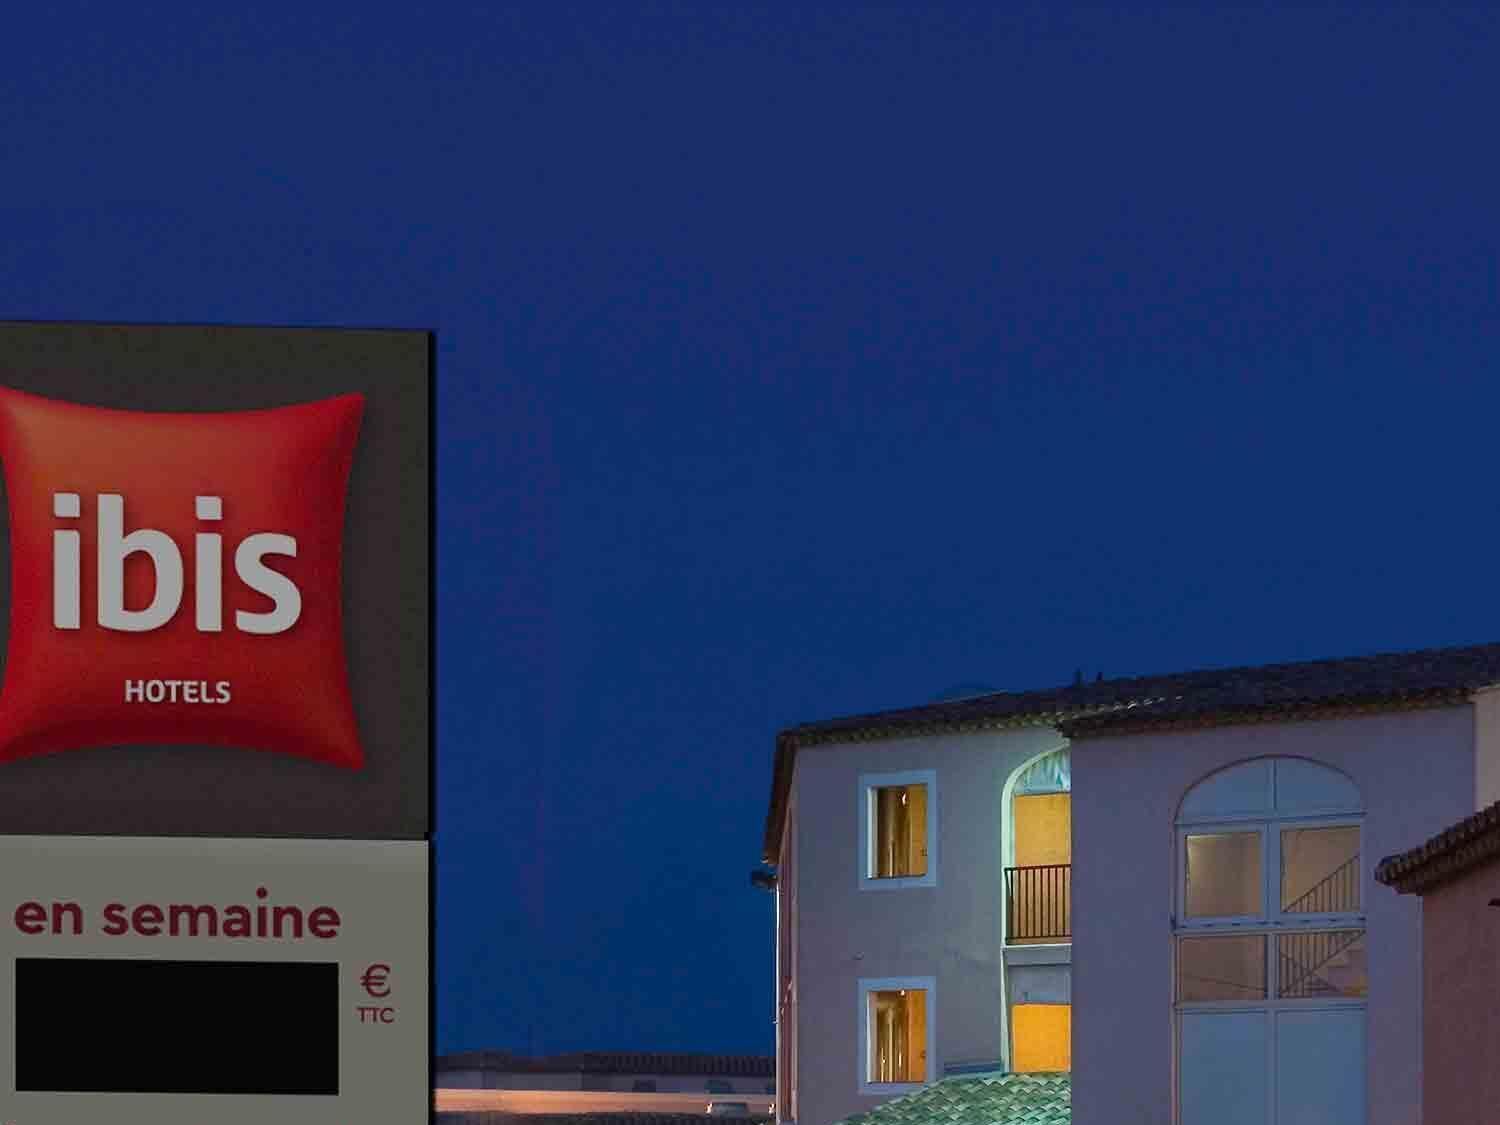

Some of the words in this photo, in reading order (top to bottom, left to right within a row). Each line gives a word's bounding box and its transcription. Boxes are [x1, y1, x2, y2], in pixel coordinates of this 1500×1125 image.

[53, 492, 303, 635] ibis
[125, 679, 231, 704] HOTELS
[14, 900, 83, 935] en
[102, 887, 341, 939] semaine
[360, 964, 391, 998] €
[357, 1007, 394, 1023] TTC
